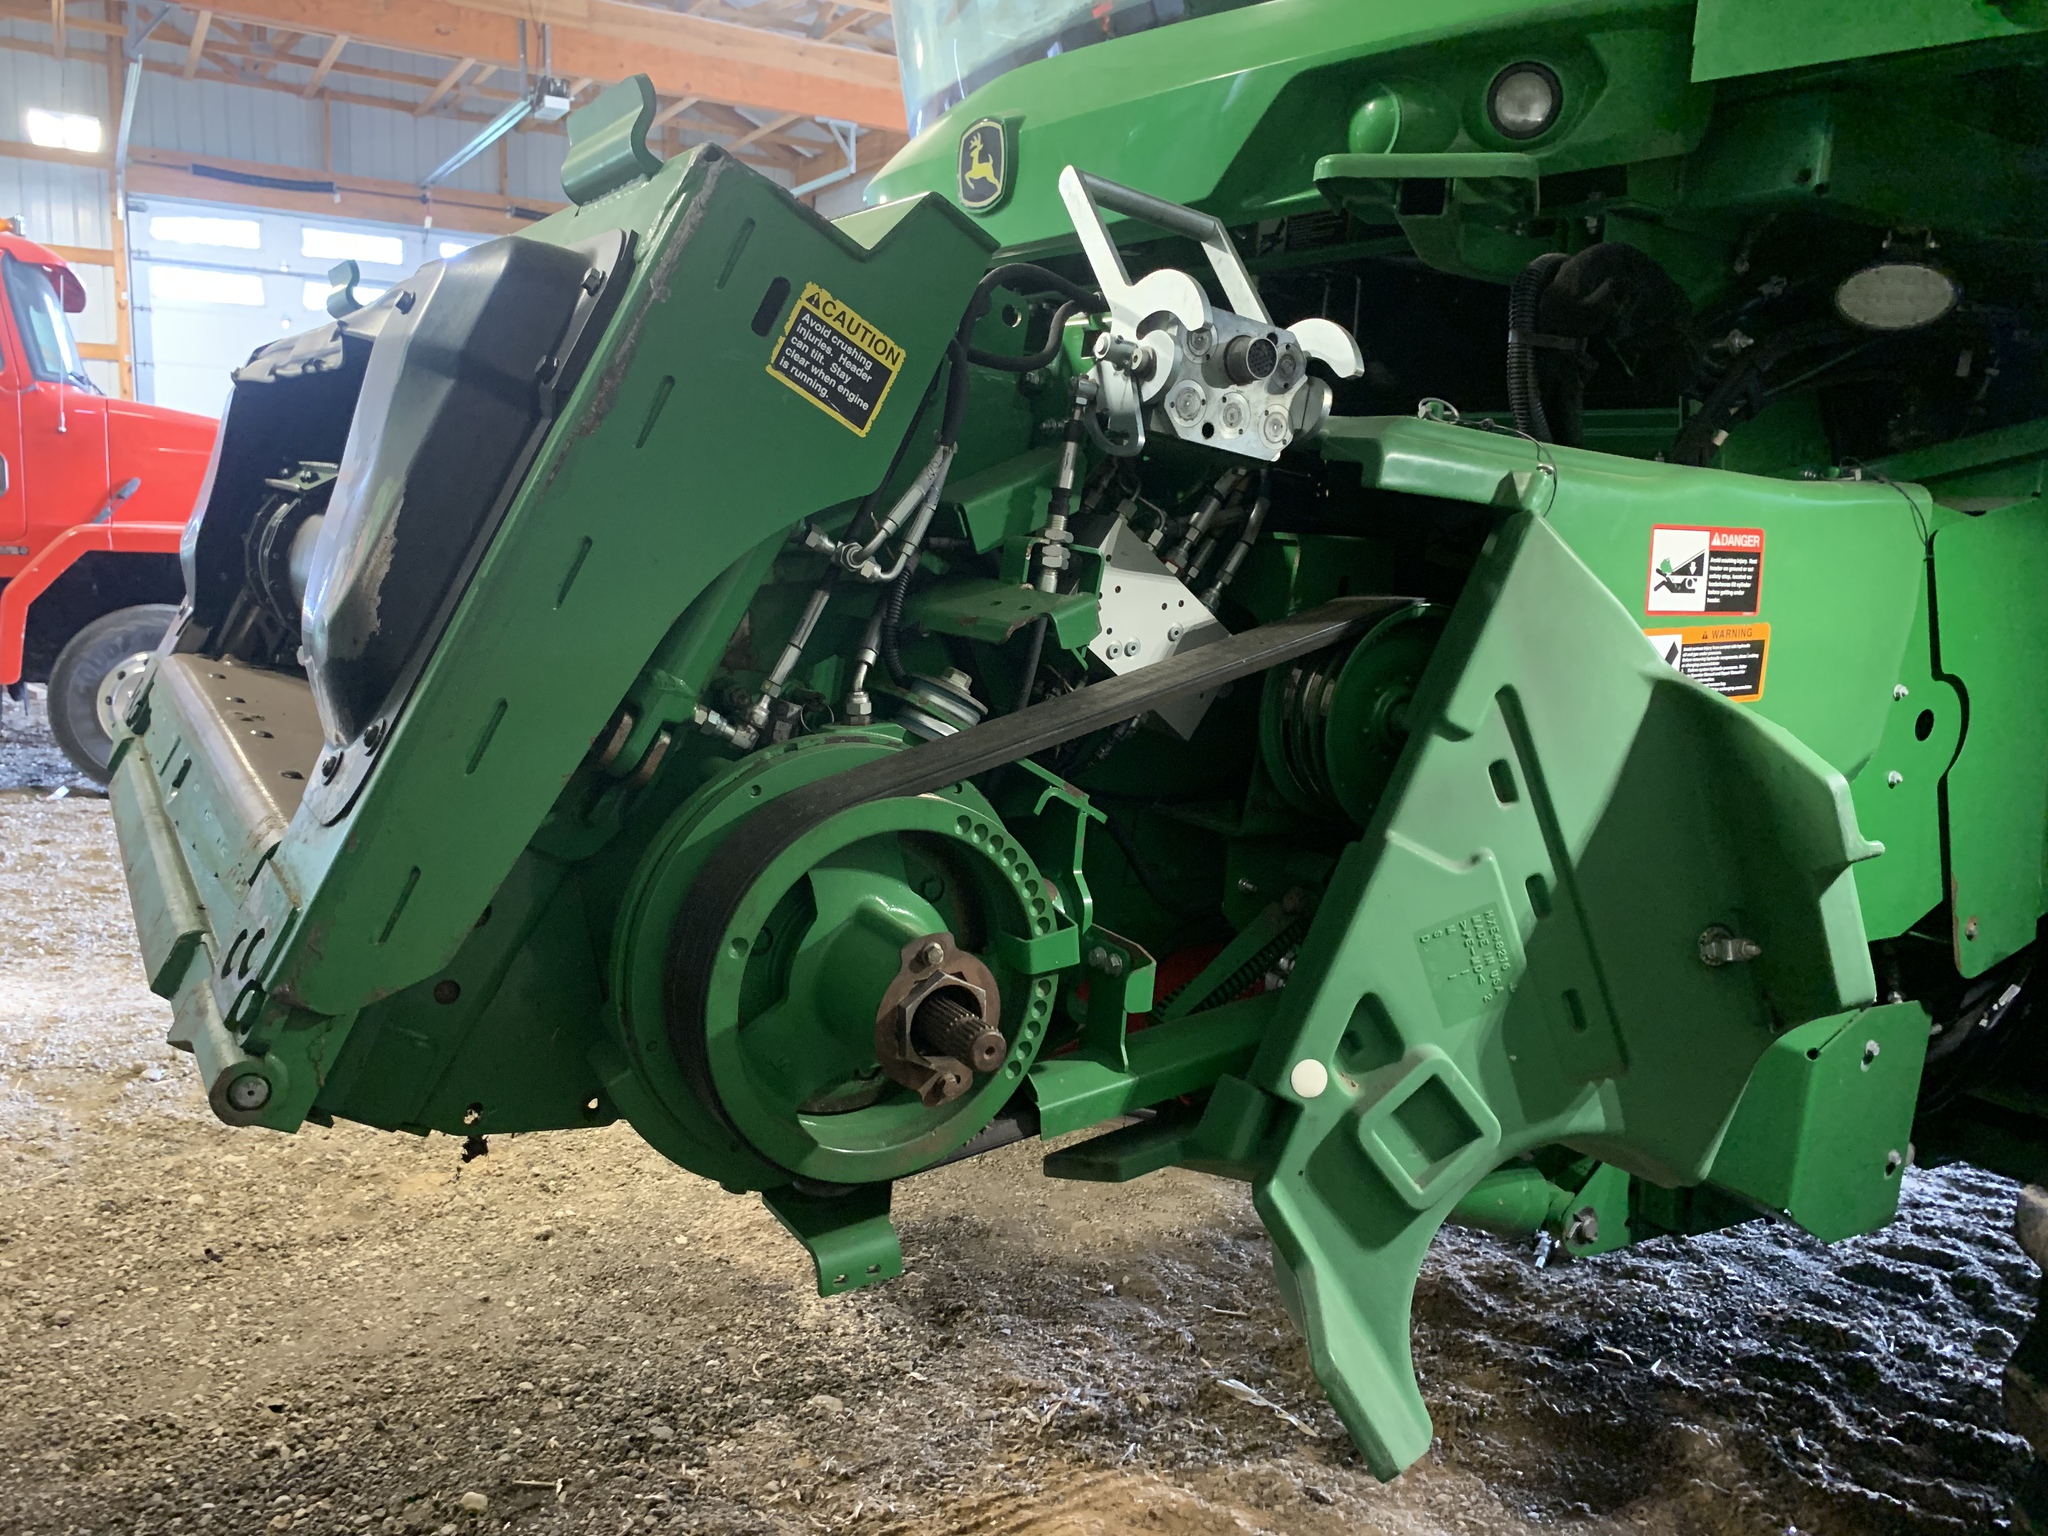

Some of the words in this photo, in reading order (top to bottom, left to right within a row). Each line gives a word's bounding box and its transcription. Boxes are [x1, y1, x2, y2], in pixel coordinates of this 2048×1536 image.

[790, 336, 810, 354] can
[810, 348, 825, 366] tilt.
[829, 363, 852, 385] Stay
[796, 323, 834, 357] injuries.
[838, 355, 873, 384] Header
[801, 313, 832, 339] Avoid
[831, 335, 873, 371] crushing
[822, 300, 901, 366] CAUTION
[779, 356, 789, 370] is
[789, 366, 830, 399] running.
[785, 346, 811, 370] clear
[810, 363, 836, 388] when
[837, 384, 870, 411] engine
[1721, 533, 1760, 548] DANGER
[1712, 628, 1753, 639] WARNING
[1470, 914, 1489, 948] MADE
[1482, 951, 1496, 967] IN
[1489, 969, 1504, 995] USA
